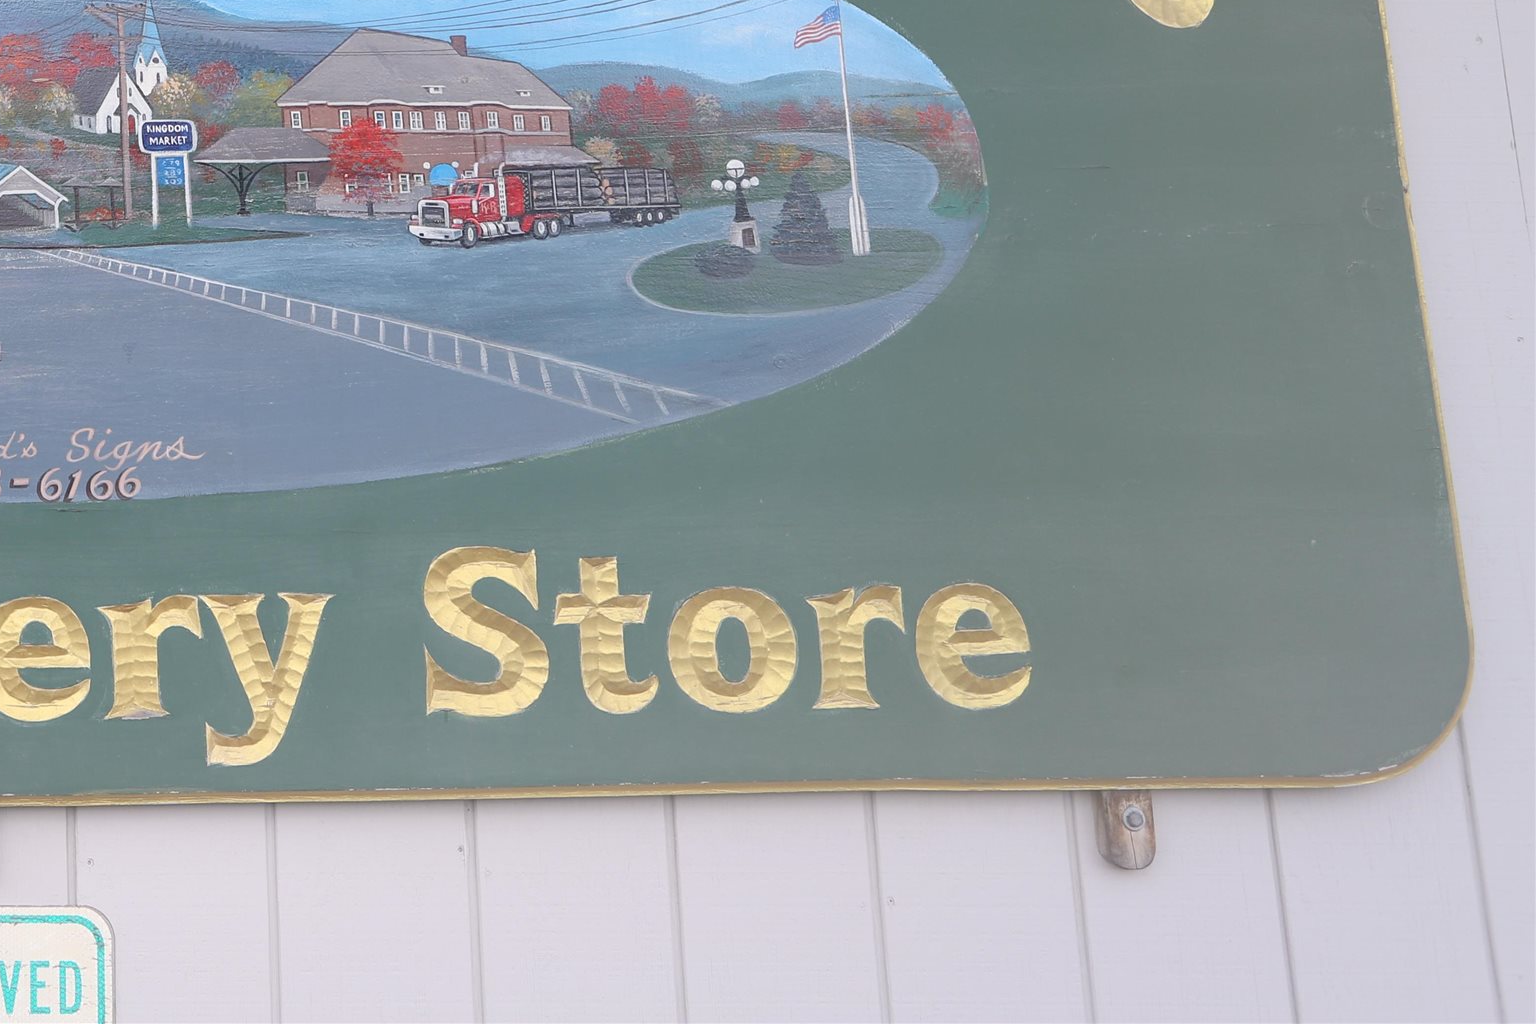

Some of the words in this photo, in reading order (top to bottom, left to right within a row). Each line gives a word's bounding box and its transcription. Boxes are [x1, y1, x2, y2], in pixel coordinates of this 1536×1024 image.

[146, 124, 189, 133] KINGDOM
[149, 135, 188, 146] MARKET
[66, 427, 206, 471] Signs
[424, 546, 1031, 718] Store
